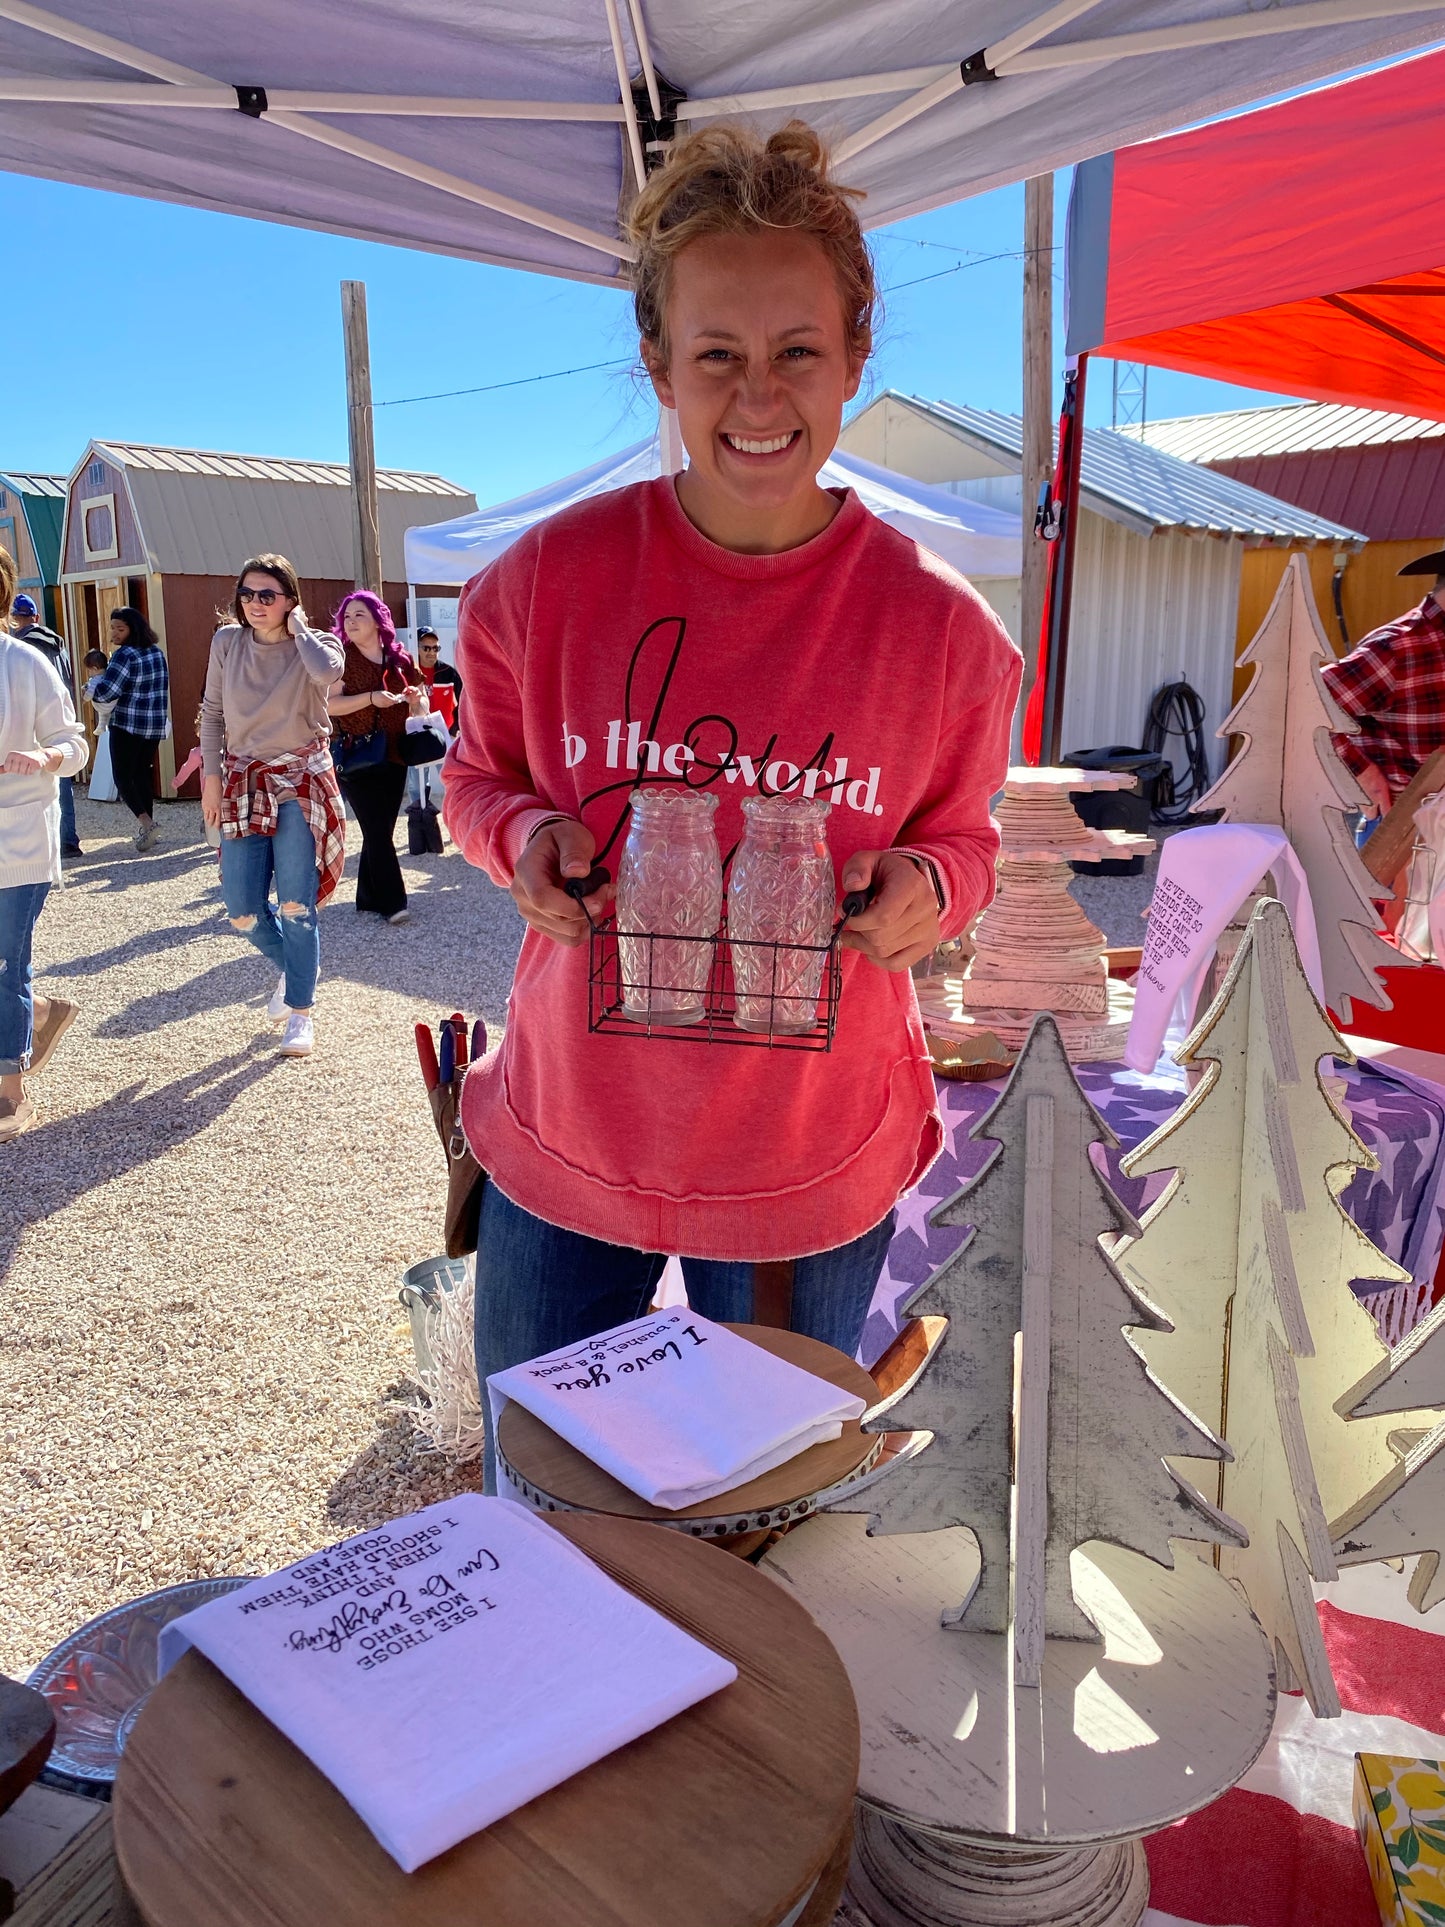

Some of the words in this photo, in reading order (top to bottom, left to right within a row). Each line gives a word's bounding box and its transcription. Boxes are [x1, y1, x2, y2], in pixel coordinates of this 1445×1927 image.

[603, 719, 695, 775] the
[717, 752, 884, 817] world.
[1155, 885, 1180, 913] RIENDS
[1178, 907, 1193, 925] FOR
[1191, 920, 1203, 933] SO
[1162, 877, 1185, 900] WE'VE
[1183, 895, 1203, 916] BEEN
[1166, 913, 1173, 924] I
[1149, 912, 1172, 940] EMBER
[1170, 934, 1191, 958] WHICH
[1154, 937, 1166, 949] OF
[1164, 945, 1175, 959] US
[1149, 947, 1164, 966] THE
[606, 1325, 671, 1354] bushel
[682, 1325, 708, 1346] I
[529, 1362, 574, 1378] peck
[617, 1341, 682, 1373] love
[551, 1363, 611, 1391] you
[442, 1517, 459, 1528] I
[338, 1535, 392, 1561] COME
[364, 1525, 442, 1563] SHOULD
[389, 1542, 442, 1571] THEN
[291, 1558, 332, 1580] AND
[304, 1561, 361, 1588] HAVE
[373, 1566, 389, 1576] I
[457, 1549, 499, 1578] Can
[238, 1584, 302, 1615] THEM
[356, 1574, 396, 1597] AND
[419, 1574, 456, 1598] Do
[410, 1592, 471, 1625] MOMS
[480, 1597, 497, 1610] I
[283, 1589, 413, 1653] Everything.
[434, 1604, 479, 1633] SEE
[360, 1621, 408, 1650] WHO
[357, 1633, 433, 1670] THOSE
